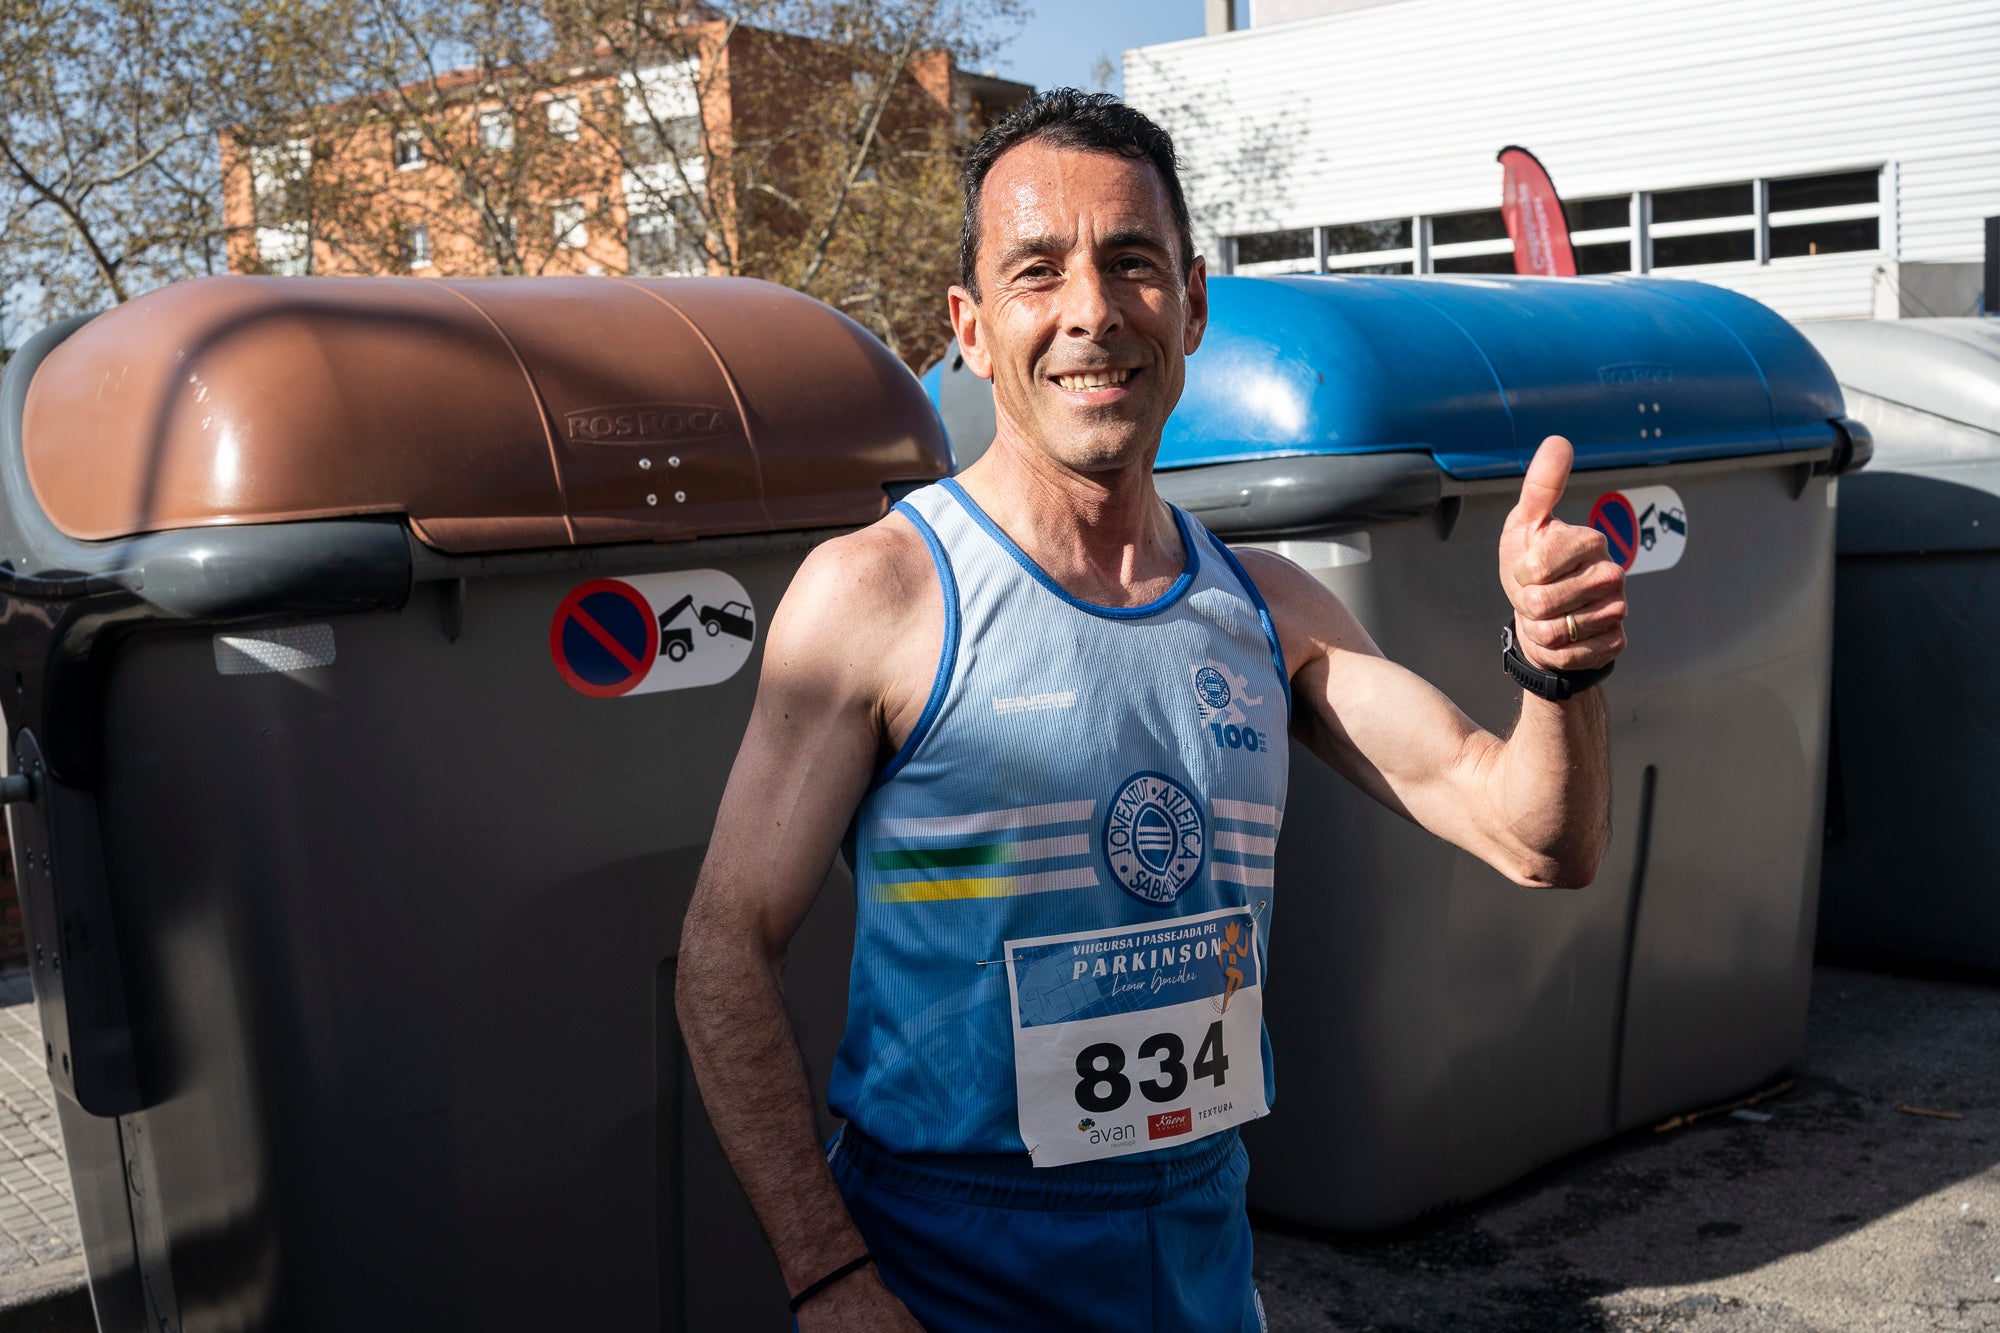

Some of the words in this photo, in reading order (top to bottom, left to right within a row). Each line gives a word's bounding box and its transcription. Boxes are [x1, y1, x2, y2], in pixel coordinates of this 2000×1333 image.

[1210, 722, 1259, 753] 100
[1109, 778, 1149, 856] JOVENTUT
[1155, 785, 1201, 859] ATLETICA
[1135, 936, 1141, 948] I
[1142, 927, 1202, 946] PASSEJADA
[1203, 922, 1217, 935] PEL
[1072, 936, 1221, 980] PARKINSON
[1111, 974, 1146, 997] Leonor
[1074, 1019, 1229, 1113] 834
[1198, 1102, 1234, 1121] TEXTURA
[1089, 1124, 1136, 1144] avan
